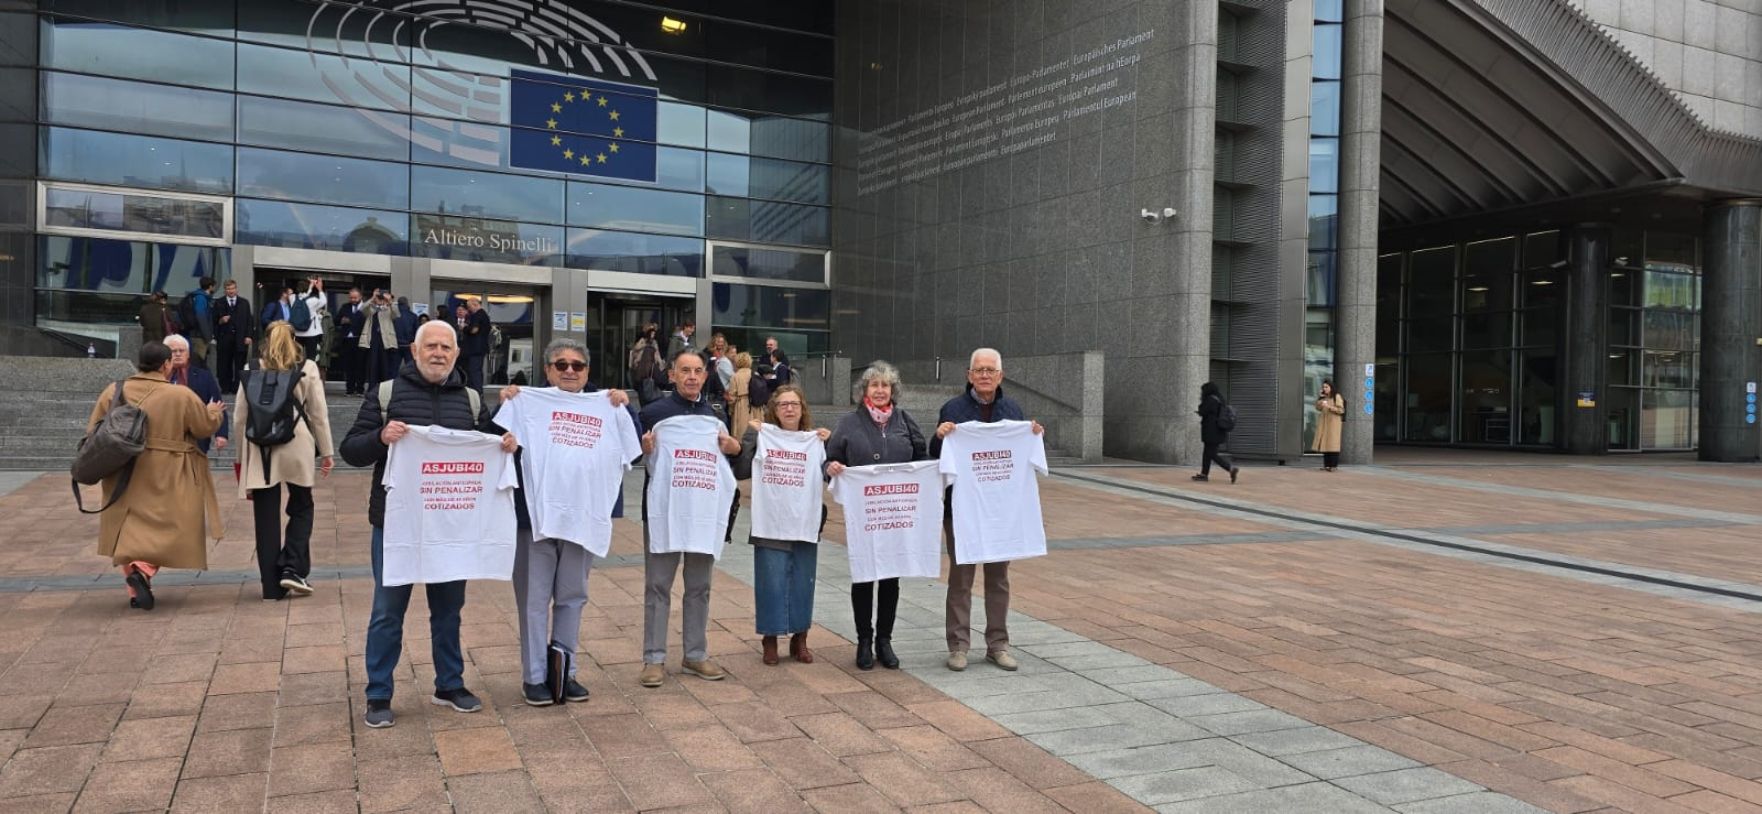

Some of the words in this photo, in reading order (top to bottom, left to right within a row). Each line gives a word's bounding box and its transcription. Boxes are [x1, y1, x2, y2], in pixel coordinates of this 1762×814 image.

[1117, 28, 1153, 50] Parlament
[424, 227, 485, 248] Altiero
[489, 233, 555, 253] Spinelli
[562, 425, 602, 439] PENALIZAR
[552, 436, 593, 449] COTIZADOS
[422, 463, 483, 473] ASJUBI40
[672, 480, 716, 491] COTIZADOS
[761, 476, 805, 488] COTIZADOS
[420, 486, 433, 494] SIN
[434, 486, 483, 494] PENALIZAR
[866, 484, 918, 496] ASJUBI40
[864, 521, 914, 532] COTIZADOS
